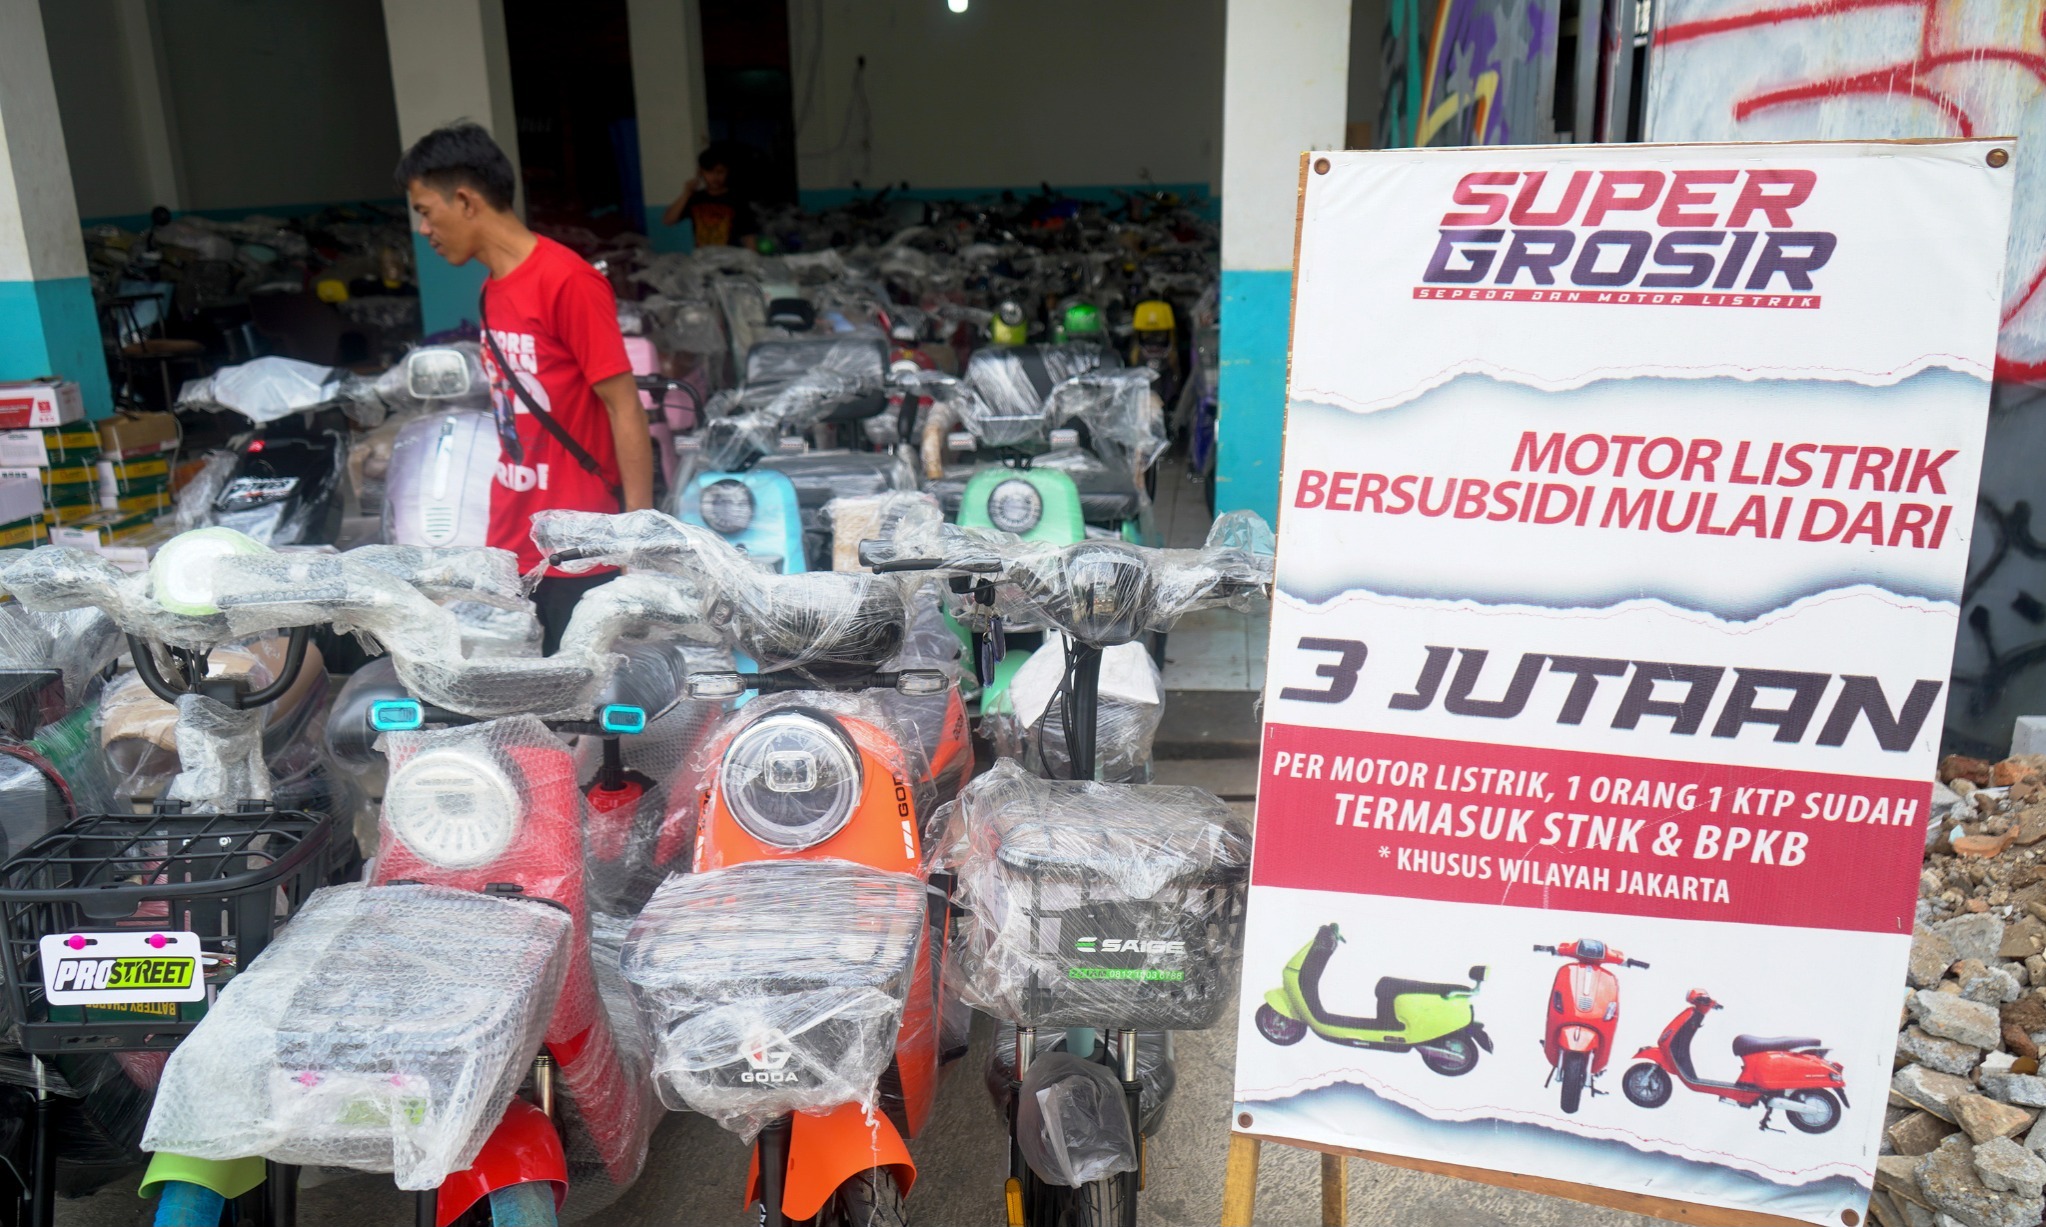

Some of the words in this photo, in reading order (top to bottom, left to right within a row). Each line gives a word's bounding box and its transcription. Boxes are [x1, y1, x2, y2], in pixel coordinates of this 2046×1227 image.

[1440, 170, 1818, 228] SUPER
[1423, 229, 1838, 291] GROSIR
[1418, 288, 1514, 302] SEPEDA
[1531, 290, 1580, 303] DAN
[1600, 292, 1683, 305] MOTOR
[1702, 295, 1813, 307] LISTRIK
[1511, 431, 1722, 481] MOTOR
[1729, 442, 1960, 495] LISTRIK
[1294, 469, 1594, 527] BERSUBSIDI
[1599, 488, 1793, 540] MULAI
[1798, 498, 1953, 550] DARI
[1279, 637, 1368, 704] 3
[1388, 645, 1943, 752] JUTAAN
[1273, 751, 1324, 780] PER
[1330, 756, 1428, 788] MOTOR
[1434, 764, 1555, 803] LISTRIK,
[1567, 775, 1581, 801] 1
[1590, 776, 1698, 811] ORANG
[1708, 786, 1723, 813] 1
[1732, 787, 1795, 817] KTP
[1801, 792, 1919, 827] SUDAH
[1335, 793, 1534, 843] TERMASUK
[1539, 811, 1646, 854] STNK
[1652, 821, 1683, 857] &
[1693, 824, 1809, 867] BPKB
[1397, 847, 1492, 879] KHUSUS
[1498, 857, 1610, 892] WILAYAH
[1616, 870, 1730, 904] JAKARTA
[1109, 970, 1132, 979] 0812
[741, 1072, 799, 1083] GODA
